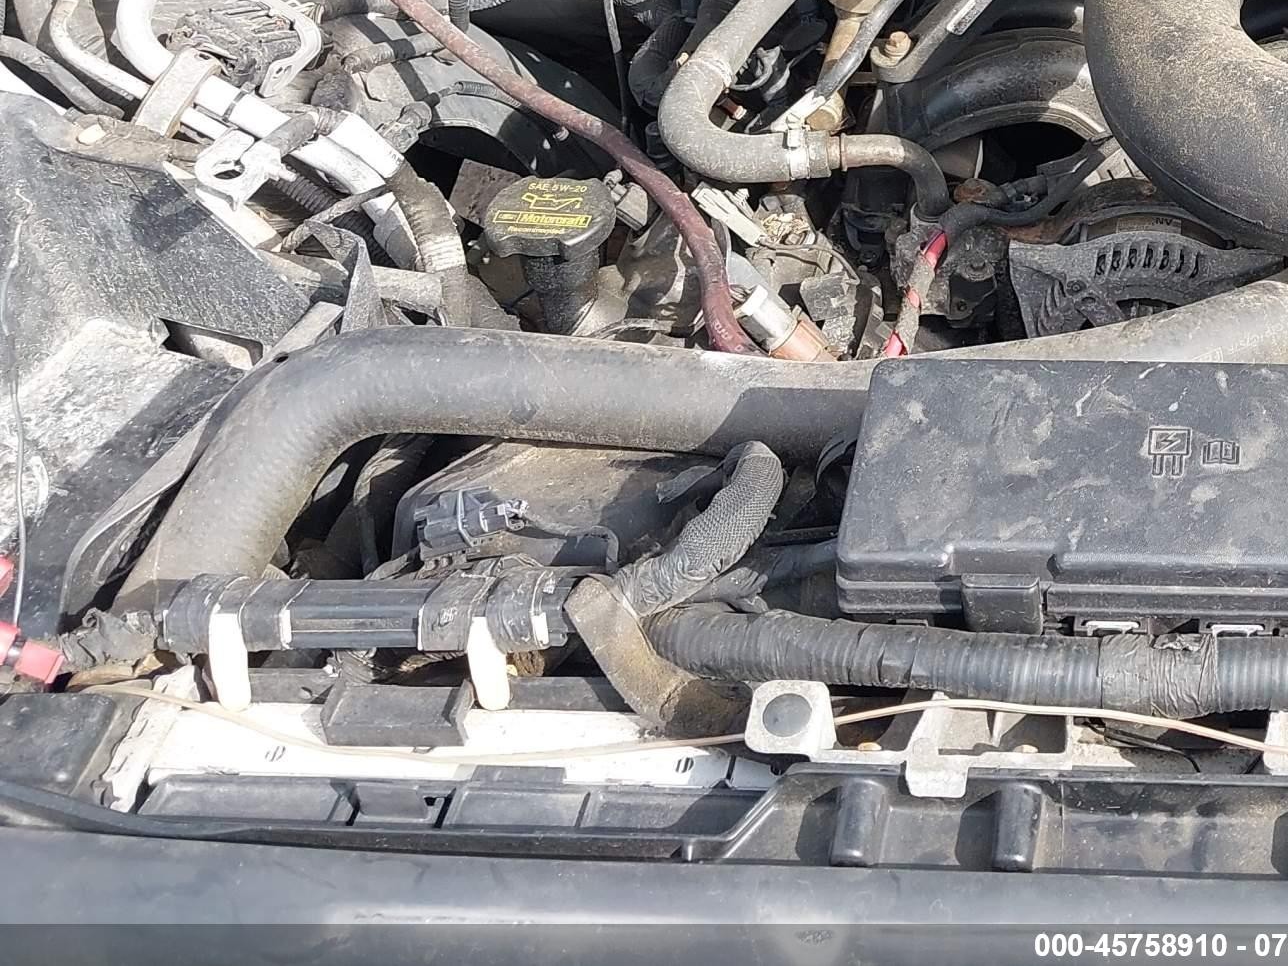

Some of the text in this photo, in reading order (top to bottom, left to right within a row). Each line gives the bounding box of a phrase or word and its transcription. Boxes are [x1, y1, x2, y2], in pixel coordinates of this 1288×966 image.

[528, 182, 588, 194] SAE 5W-20
[520, 213, 588, 226] Motorcraft
[507, 225, 566, 235] Recommended
